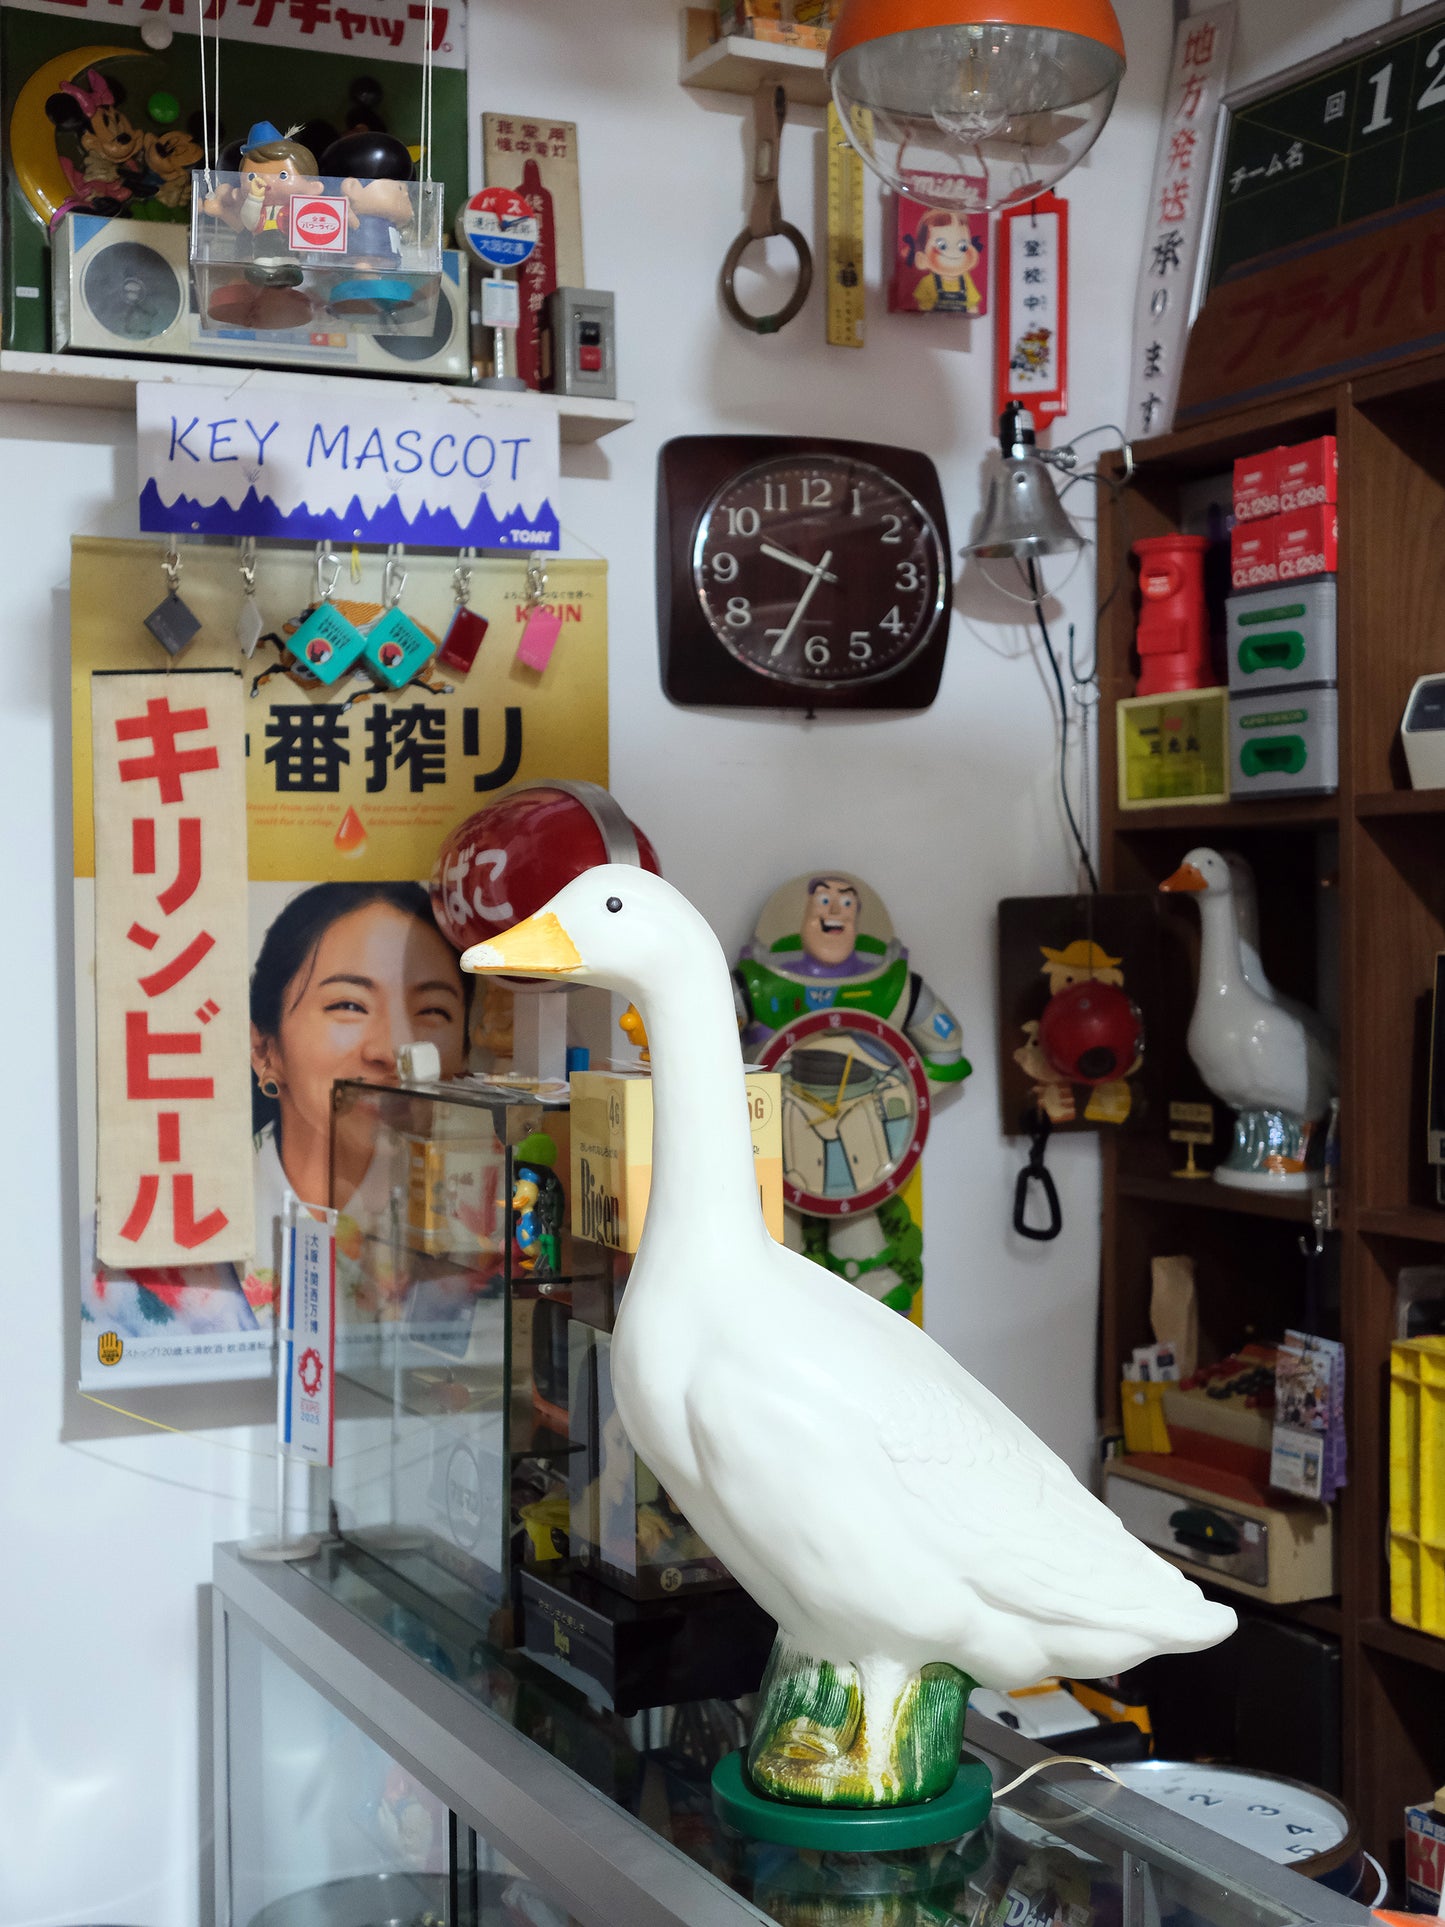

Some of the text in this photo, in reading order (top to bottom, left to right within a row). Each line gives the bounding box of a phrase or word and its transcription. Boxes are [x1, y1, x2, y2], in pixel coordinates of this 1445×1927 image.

[1322, 90, 1347, 123] 回
[1362, 62, 1393, 135] 1
[1228, 141, 1304, 193] チーム名
[480, 195, 523, 214] バス
[1141, 22, 1216, 434] 地方発送承ります
[168, 415, 532, 481] KEY MASCOT
[763, 482, 789, 512] 11
[800, 478, 832, 507] 12
[851, 488, 862, 517] 1
[509, 528, 553, 545] TOMY
[726, 506, 761, 537] 10
[880, 514, 903, 544] 2
[711, 552, 739, 583] 9
[895, 562, 919, 592] 3
[515, 604, 582, 623] KIN
[724, 596, 752, 627] 8
[879, 605, 905, 635] 4
[804, 635, 831, 666] 6
[848, 630, 872, 661] 5
[246, 703, 522, 793] 番搾り
[115, 697, 229, 1249] キリンビール
[580, 1157, 620, 1247] Bigen
[1187, 1793, 1223, 1807] 2
[1246, 1803, 1281, 1818] 3
[1285, 1822, 1315, 1838] 4
